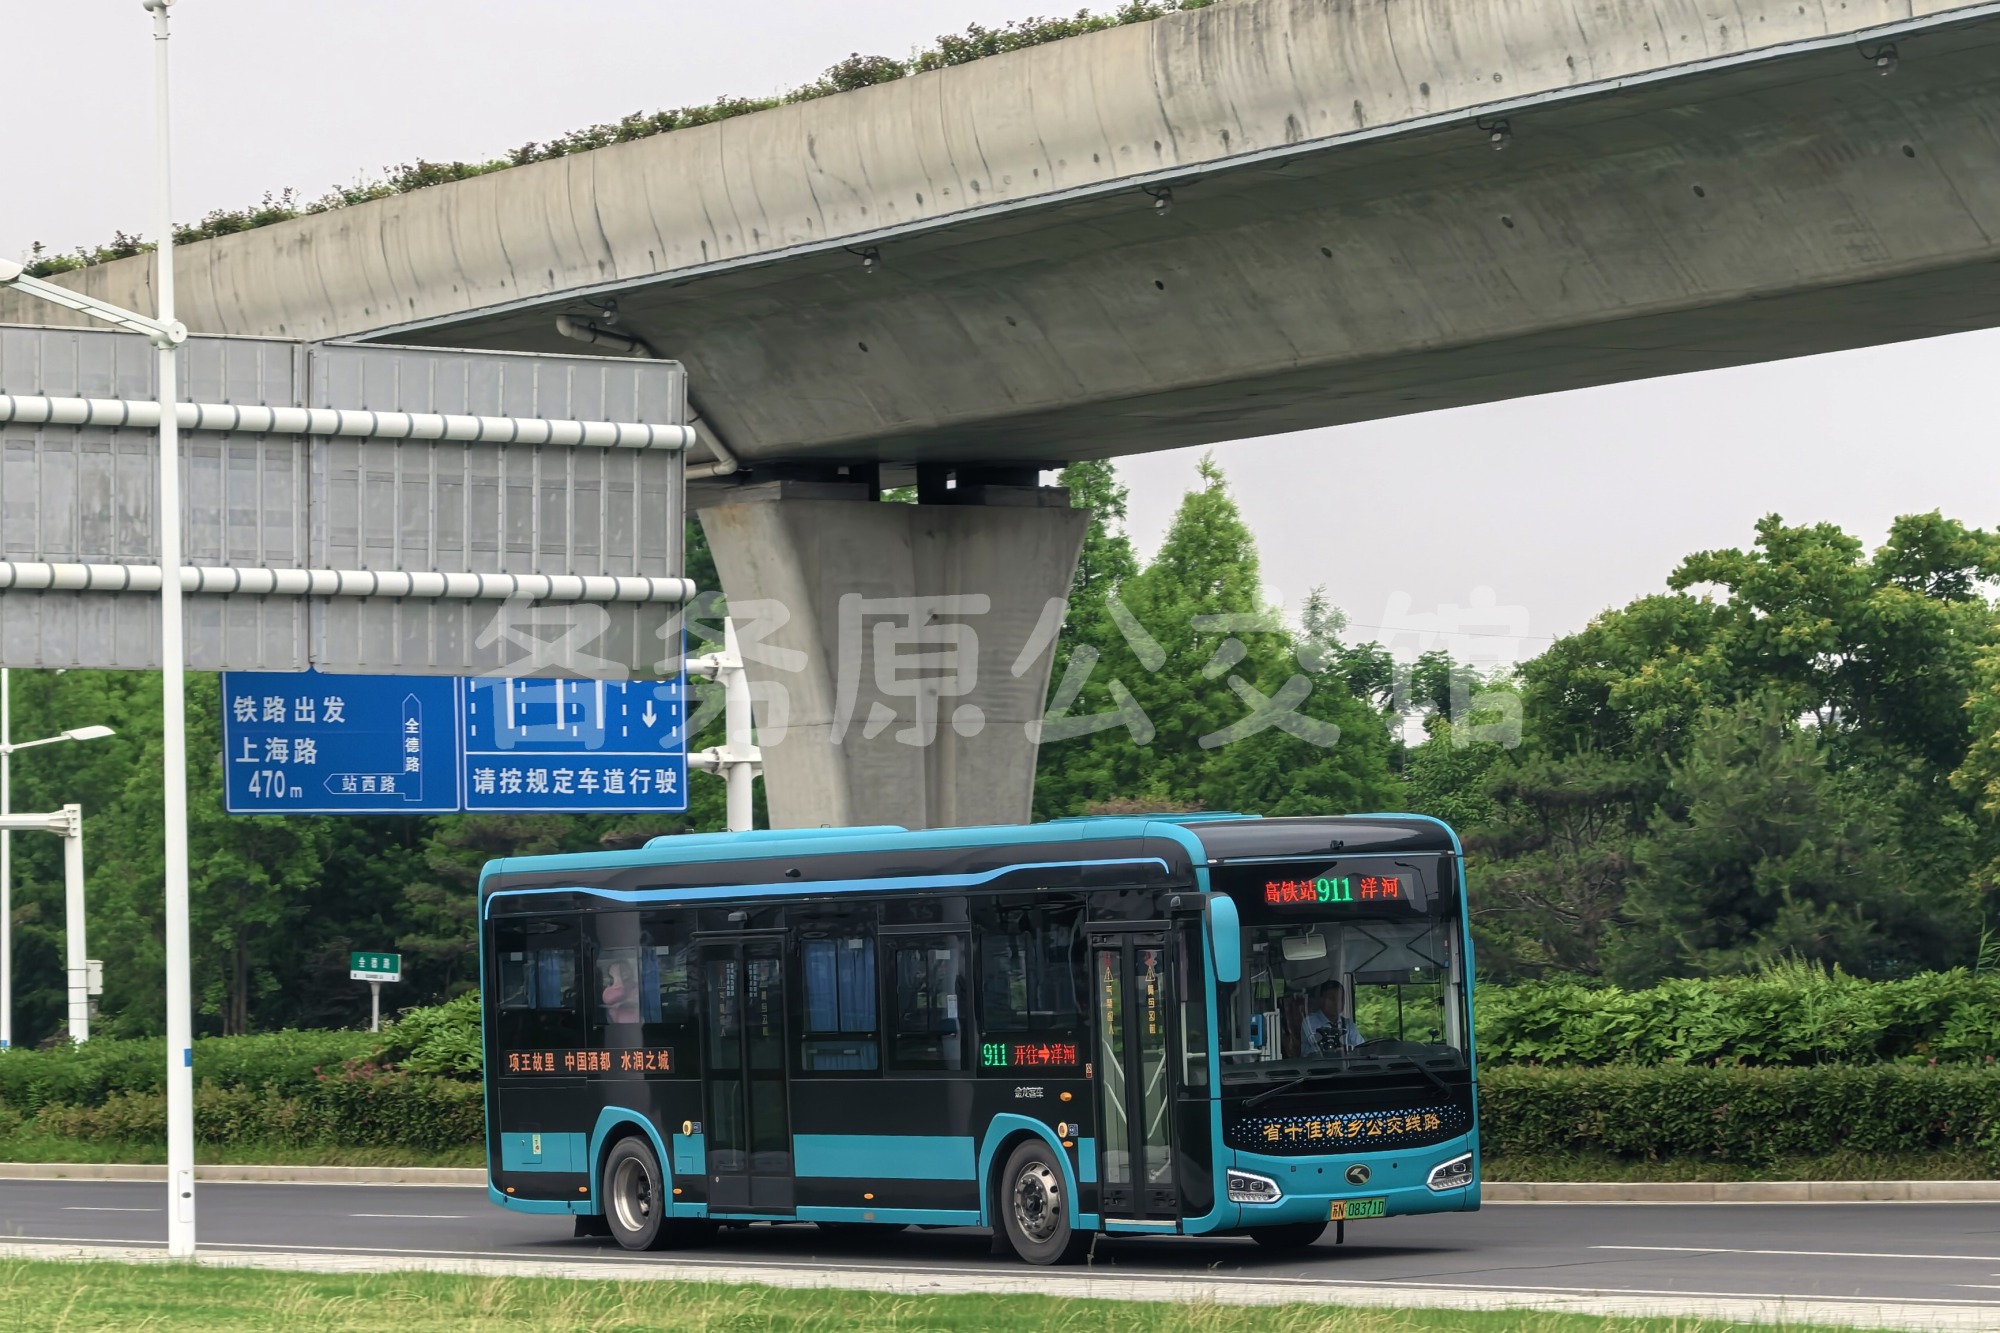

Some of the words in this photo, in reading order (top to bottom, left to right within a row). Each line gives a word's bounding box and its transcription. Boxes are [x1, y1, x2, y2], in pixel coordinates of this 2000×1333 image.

[233, 696, 346, 723] 铁路出发
[235, 737, 318, 764] 上海路
[405, 718, 420, 772] 全德路
[342, 775, 396, 793] 站西路
[473, 768, 677, 794] 请按规定车道行驶
[1361, 877, 1399, 899] 洋河
[509, 1051, 555, 1072] 项王故里
[565, 1051, 611, 1072] 中国酒都
[621, 1050, 670, 1071] 水润之城
[983, 1043, 1008, 1066] 911
[1263, 1113, 1441, 1142] 省十佳城乡公交线路
